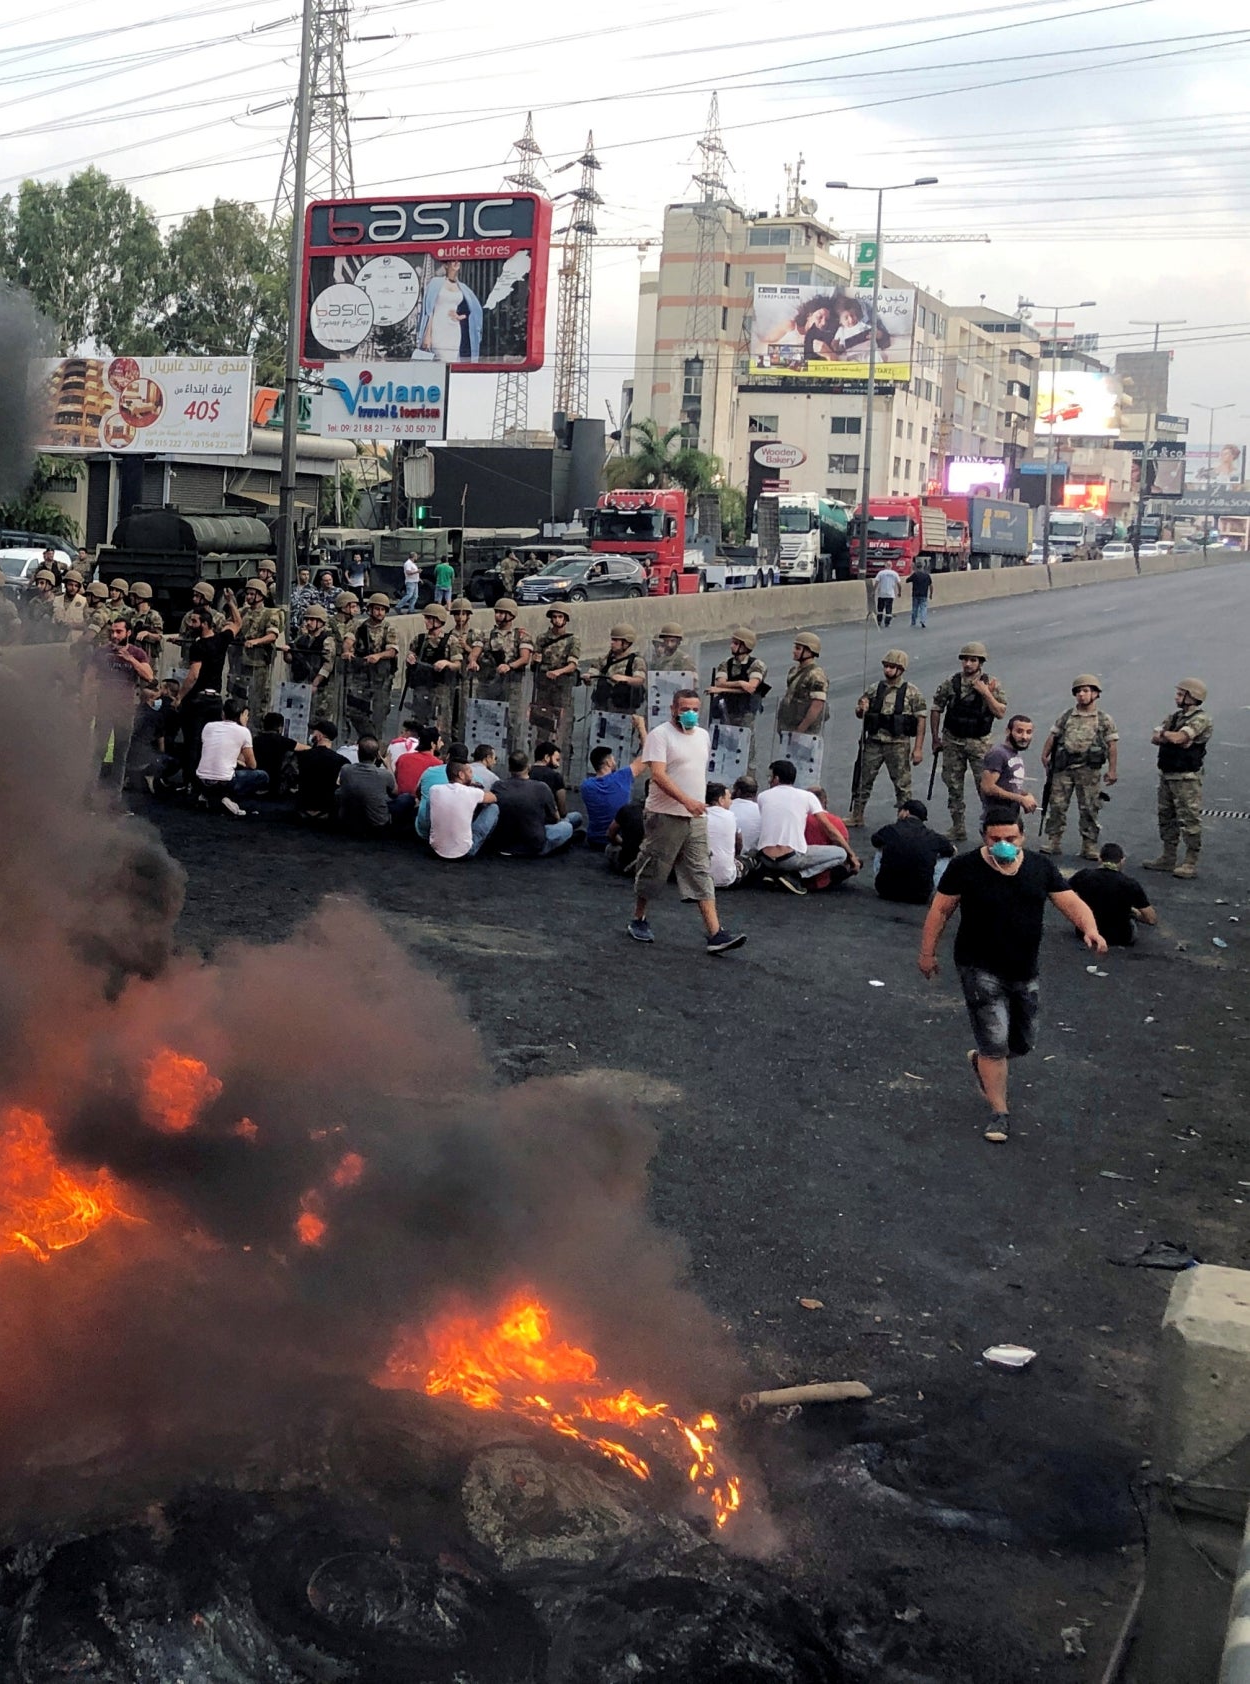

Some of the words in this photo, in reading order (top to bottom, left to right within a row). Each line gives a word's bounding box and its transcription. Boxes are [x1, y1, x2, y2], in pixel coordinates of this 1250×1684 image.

[437, 246, 471, 258] outlet
[474, 243, 510, 256] stores
[188, 359, 213, 375] غراند
[217, 359, 247, 375] فندق
[174, 387, 184, 395] من
[211, 384, 232, 396] غرفة
[326, 370, 442, 416] Viviane
[183, 399, 221, 422] 40$
[358, 404, 389, 418] travel
[390, 405, 398, 418] &
[400, 405, 440, 418] tourism
[353, 424, 362, 432] 21
[375, 424, 383, 432] 21
[405, 425, 414, 433] 30
[416, 425, 425, 433] 50
[427, 425, 436, 433] 70
[762, 448, 797, 456] Wooden
[766, 456, 796, 465] Bakery
[954, 455, 984, 463] HANNA
